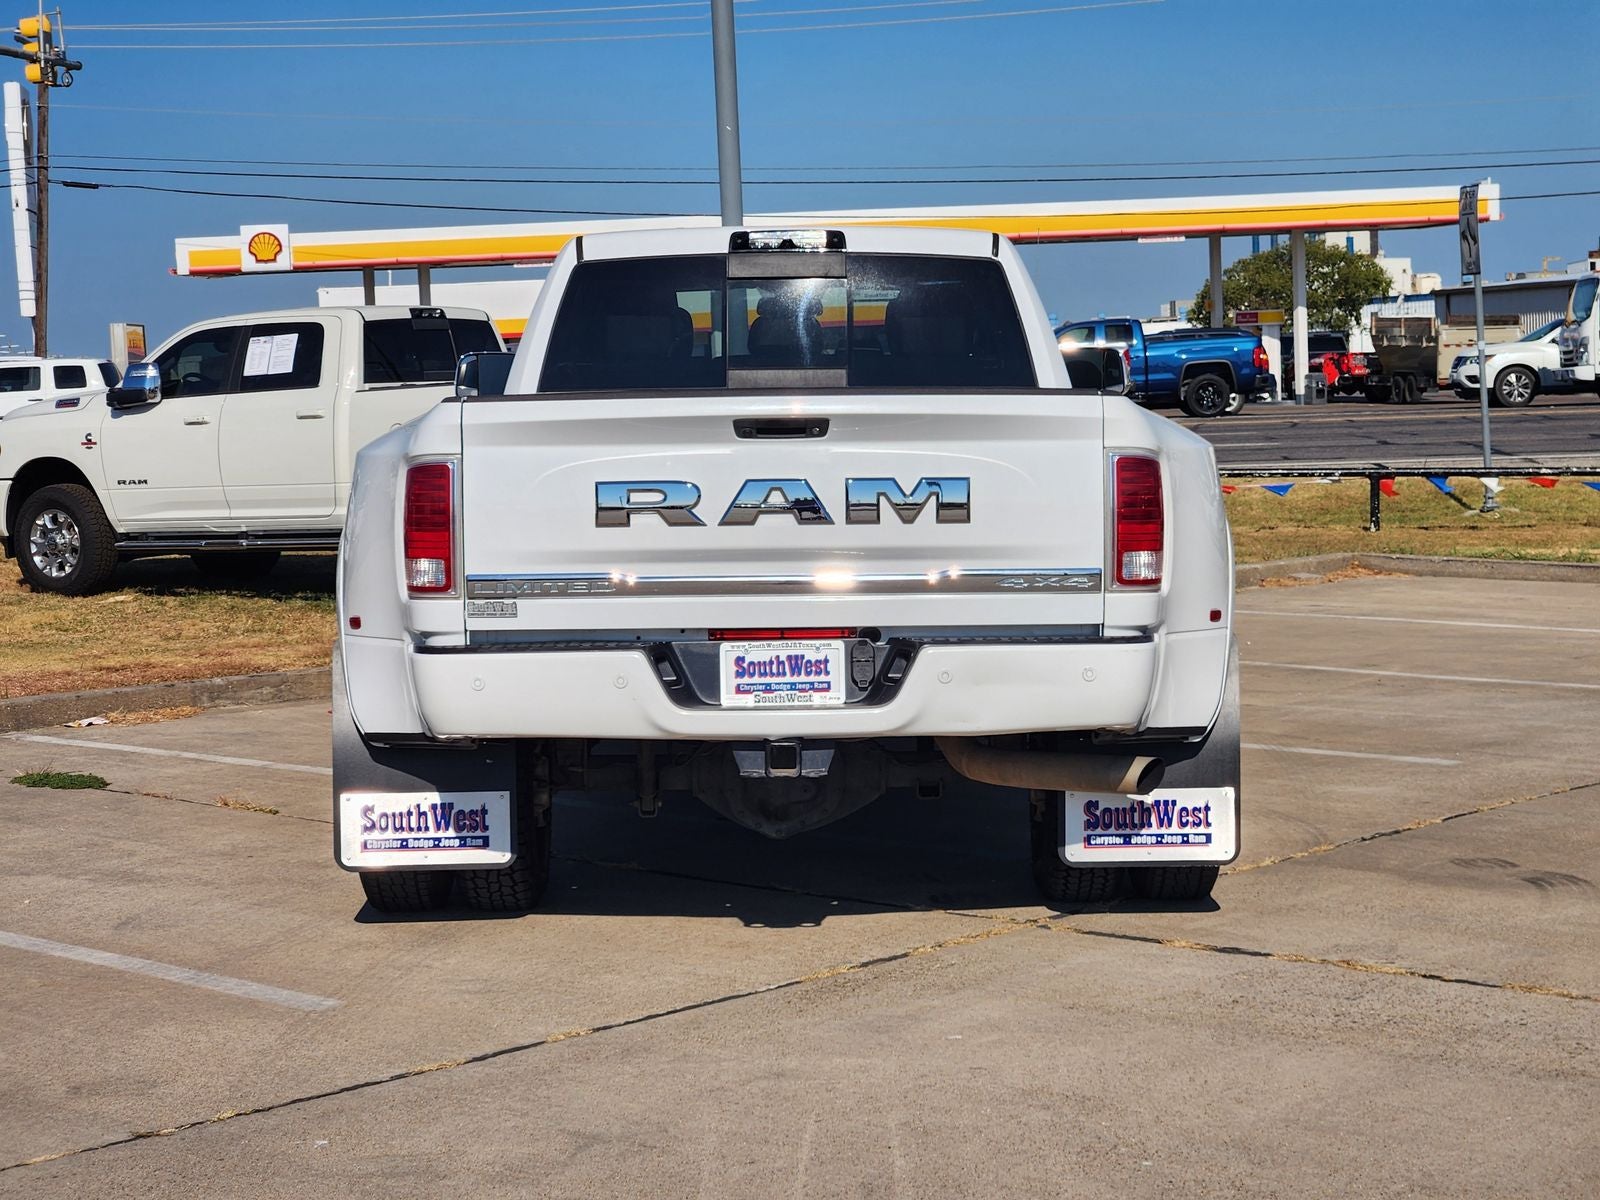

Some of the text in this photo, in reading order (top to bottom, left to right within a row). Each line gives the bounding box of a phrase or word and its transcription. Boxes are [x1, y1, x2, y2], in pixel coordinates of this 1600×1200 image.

[595, 477, 971, 528] RAM
[474, 581, 616, 594] LIMITED
[734, 653, 831, 679] SouthWest
[740, 684, 765, 692] Chrysler
[771, 683, 791, 691] Dodge
[796, 683, 810, 691] Jeep
[754, 693, 814, 704] SouthWest
[360, 802, 490, 835] SouthWest
[1083, 799, 1212, 832] SouthWest
[366, 837, 483, 849] Chrysler Dodge Jeep Ram
[1090, 834, 1206, 846] Chrysler Dodge Jeep Ram
